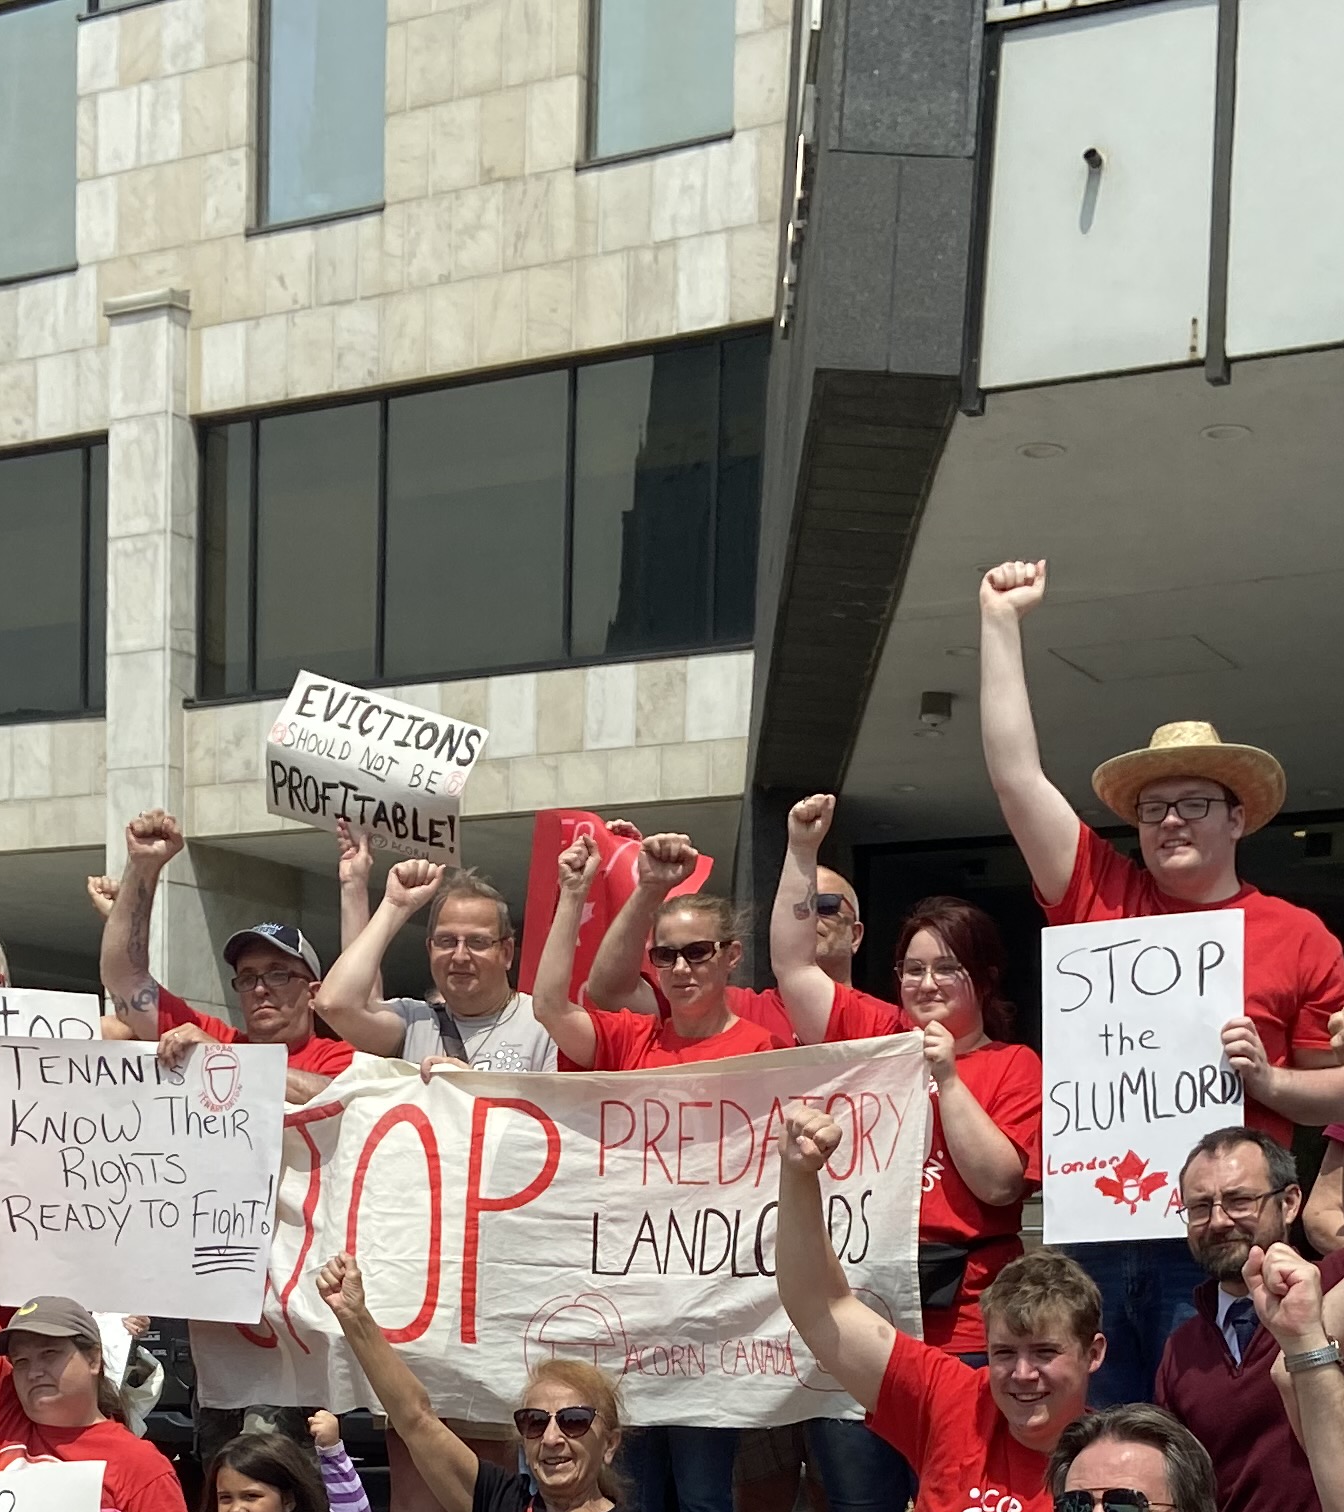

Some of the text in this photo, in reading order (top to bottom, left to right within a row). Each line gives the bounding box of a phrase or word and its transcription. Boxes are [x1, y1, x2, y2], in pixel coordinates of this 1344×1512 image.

[282, 722, 443, 795] SHOULD NOT BE
[296, 684, 481, 766] EVICTIONS
[270, 760, 456, 854] PROFITABLE!
[1057, 939, 1224, 1012] STOP
[1099, 1023, 1160, 1056] the
[10, 1099, 142, 1146] KNOW
[140, 1199, 179, 1228] TO
[592, 1190, 872, 1277] LANDLODS
[624, 1342, 706, 1376] ACORN
